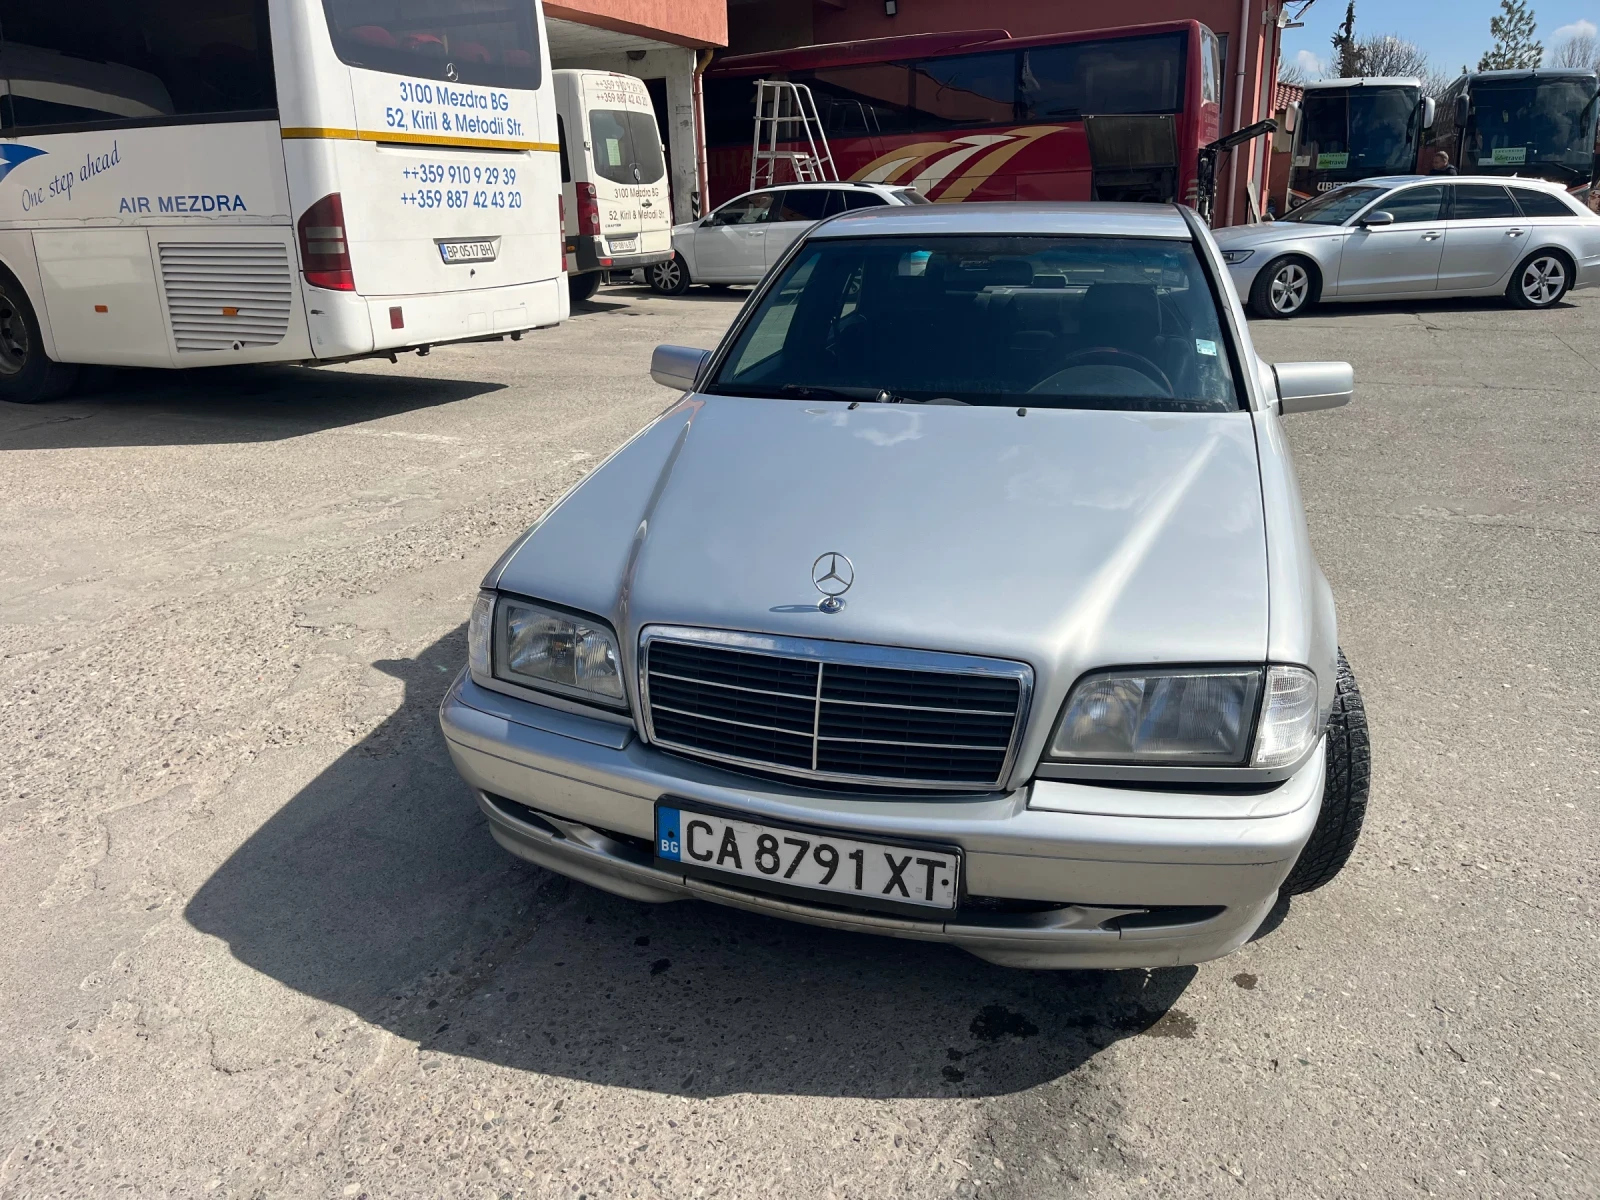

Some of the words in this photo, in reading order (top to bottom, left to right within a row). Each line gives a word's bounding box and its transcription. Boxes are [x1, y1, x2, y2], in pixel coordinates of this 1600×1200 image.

[400, 82, 432, 104] 3100
[436, 86, 488, 110] Mezdra
[490, 92, 508, 110] BG
[386, 107, 408, 131] 52,
[412, 110, 438, 130] Kiril
[442, 112, 452, 131] &
[455, 114, 504, 135] Metodii
[507, 118, 524, 136] Str.
[22, 187, 46, 212] One
[49, 170, 74, 200] step
[79, 140, 122, 182] ahead
[402, 164, 444, 183] ++359
[448, 166, 470, 184] 910
[474, 167, 481, 183] 9
[484, 167, 499, 184] 29
[502, 168, 516, 185] 39
[401, 190, 442, 208] ++359
[446, 190, 468, 208] 887
[473, 191, 488, 208] 42
[491, 192, 504, 208] 43
[508, 192, 522, 208] 20
[614, 188, 628, 198] 3100
[119, 197, 151, 213] AIR
[158, 195, 247, 212] MEZDRA
[446, 245, 458, 258] BP
[460, 244, 478, 257] 0517
[479, 244, 492, 256] BH
[661, 840, 679, 854] BG
[686, 820, 742, 869] CA
[754, 834, 864, 890] 8791
[882, 852, 947, 900] XT
